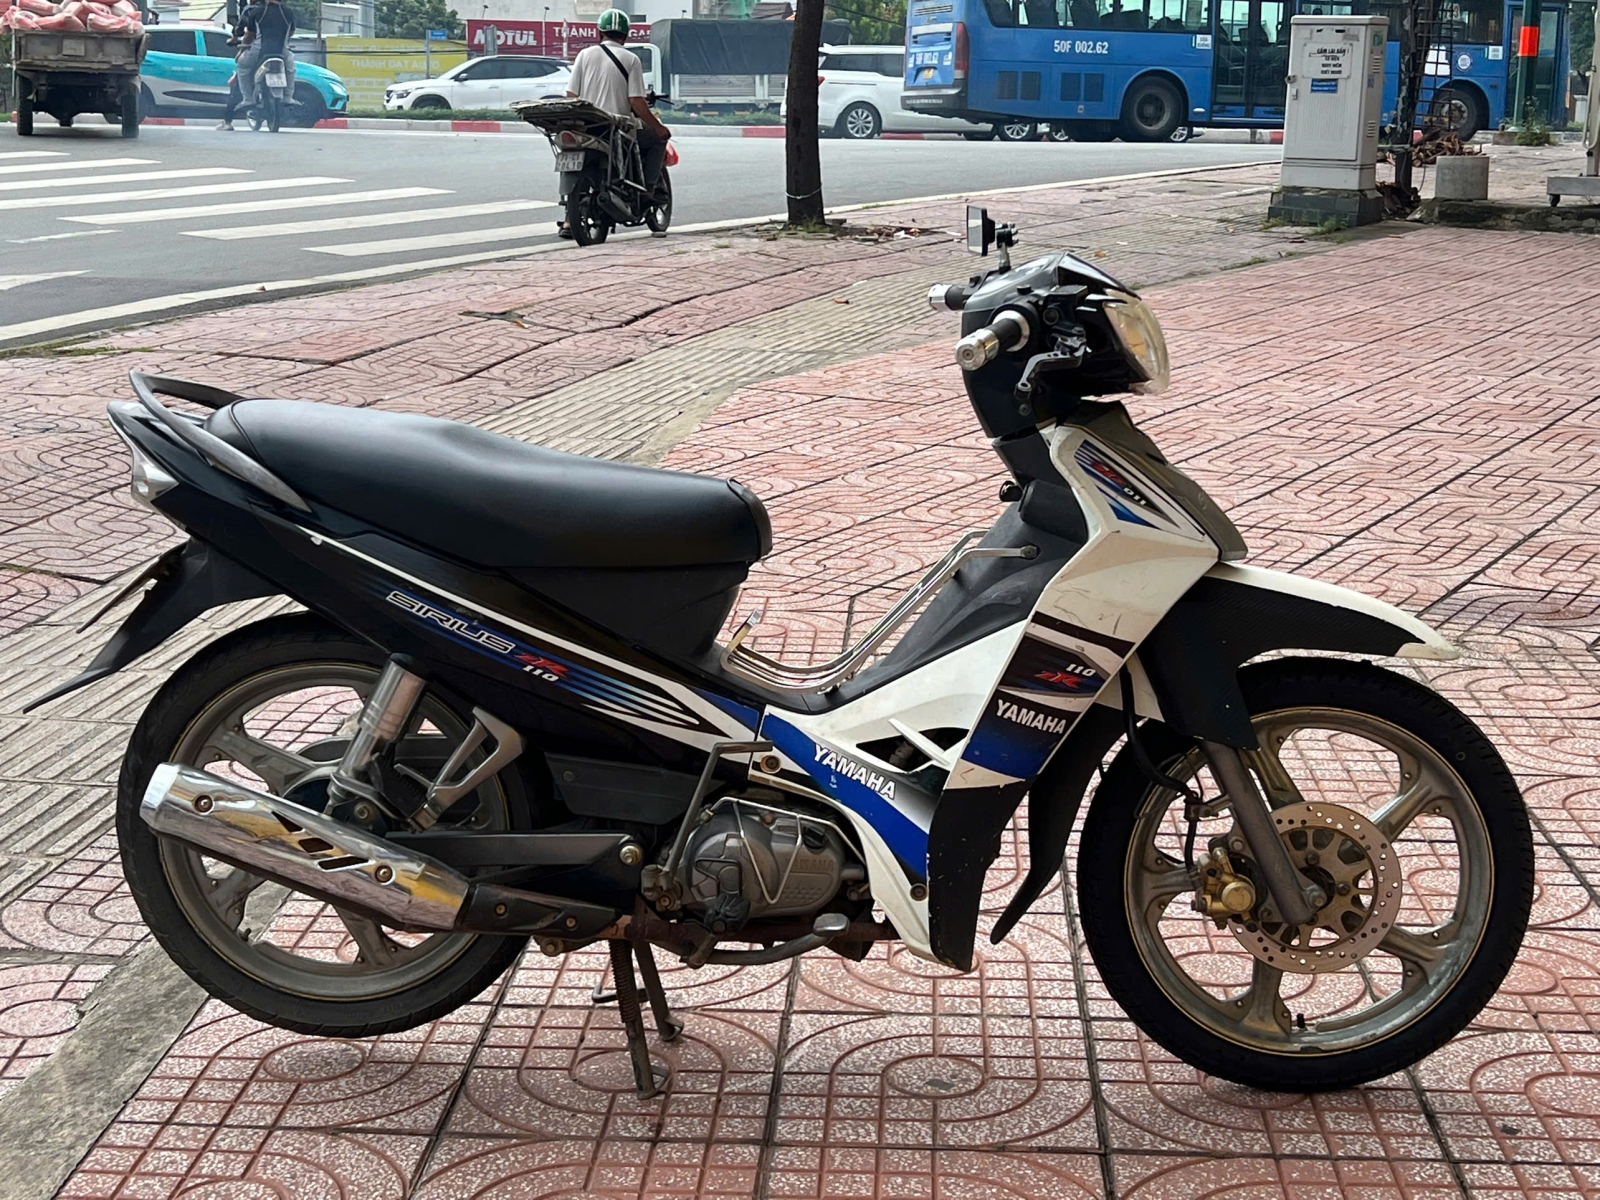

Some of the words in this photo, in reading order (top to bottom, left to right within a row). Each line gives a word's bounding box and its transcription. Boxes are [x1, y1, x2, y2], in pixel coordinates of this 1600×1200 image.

[1053, 40, 1072, 53] 50F
[1075, 40, 1109, 54] 002.62
[386, 590, 516, 653] SIRIUS
[522, 664, 559, 682] 110
[1065, 663, 1097, 677] 110
[996, 699, 1067, 734] YAMAHA
[814, 743, 896, 800] YAMAHA
